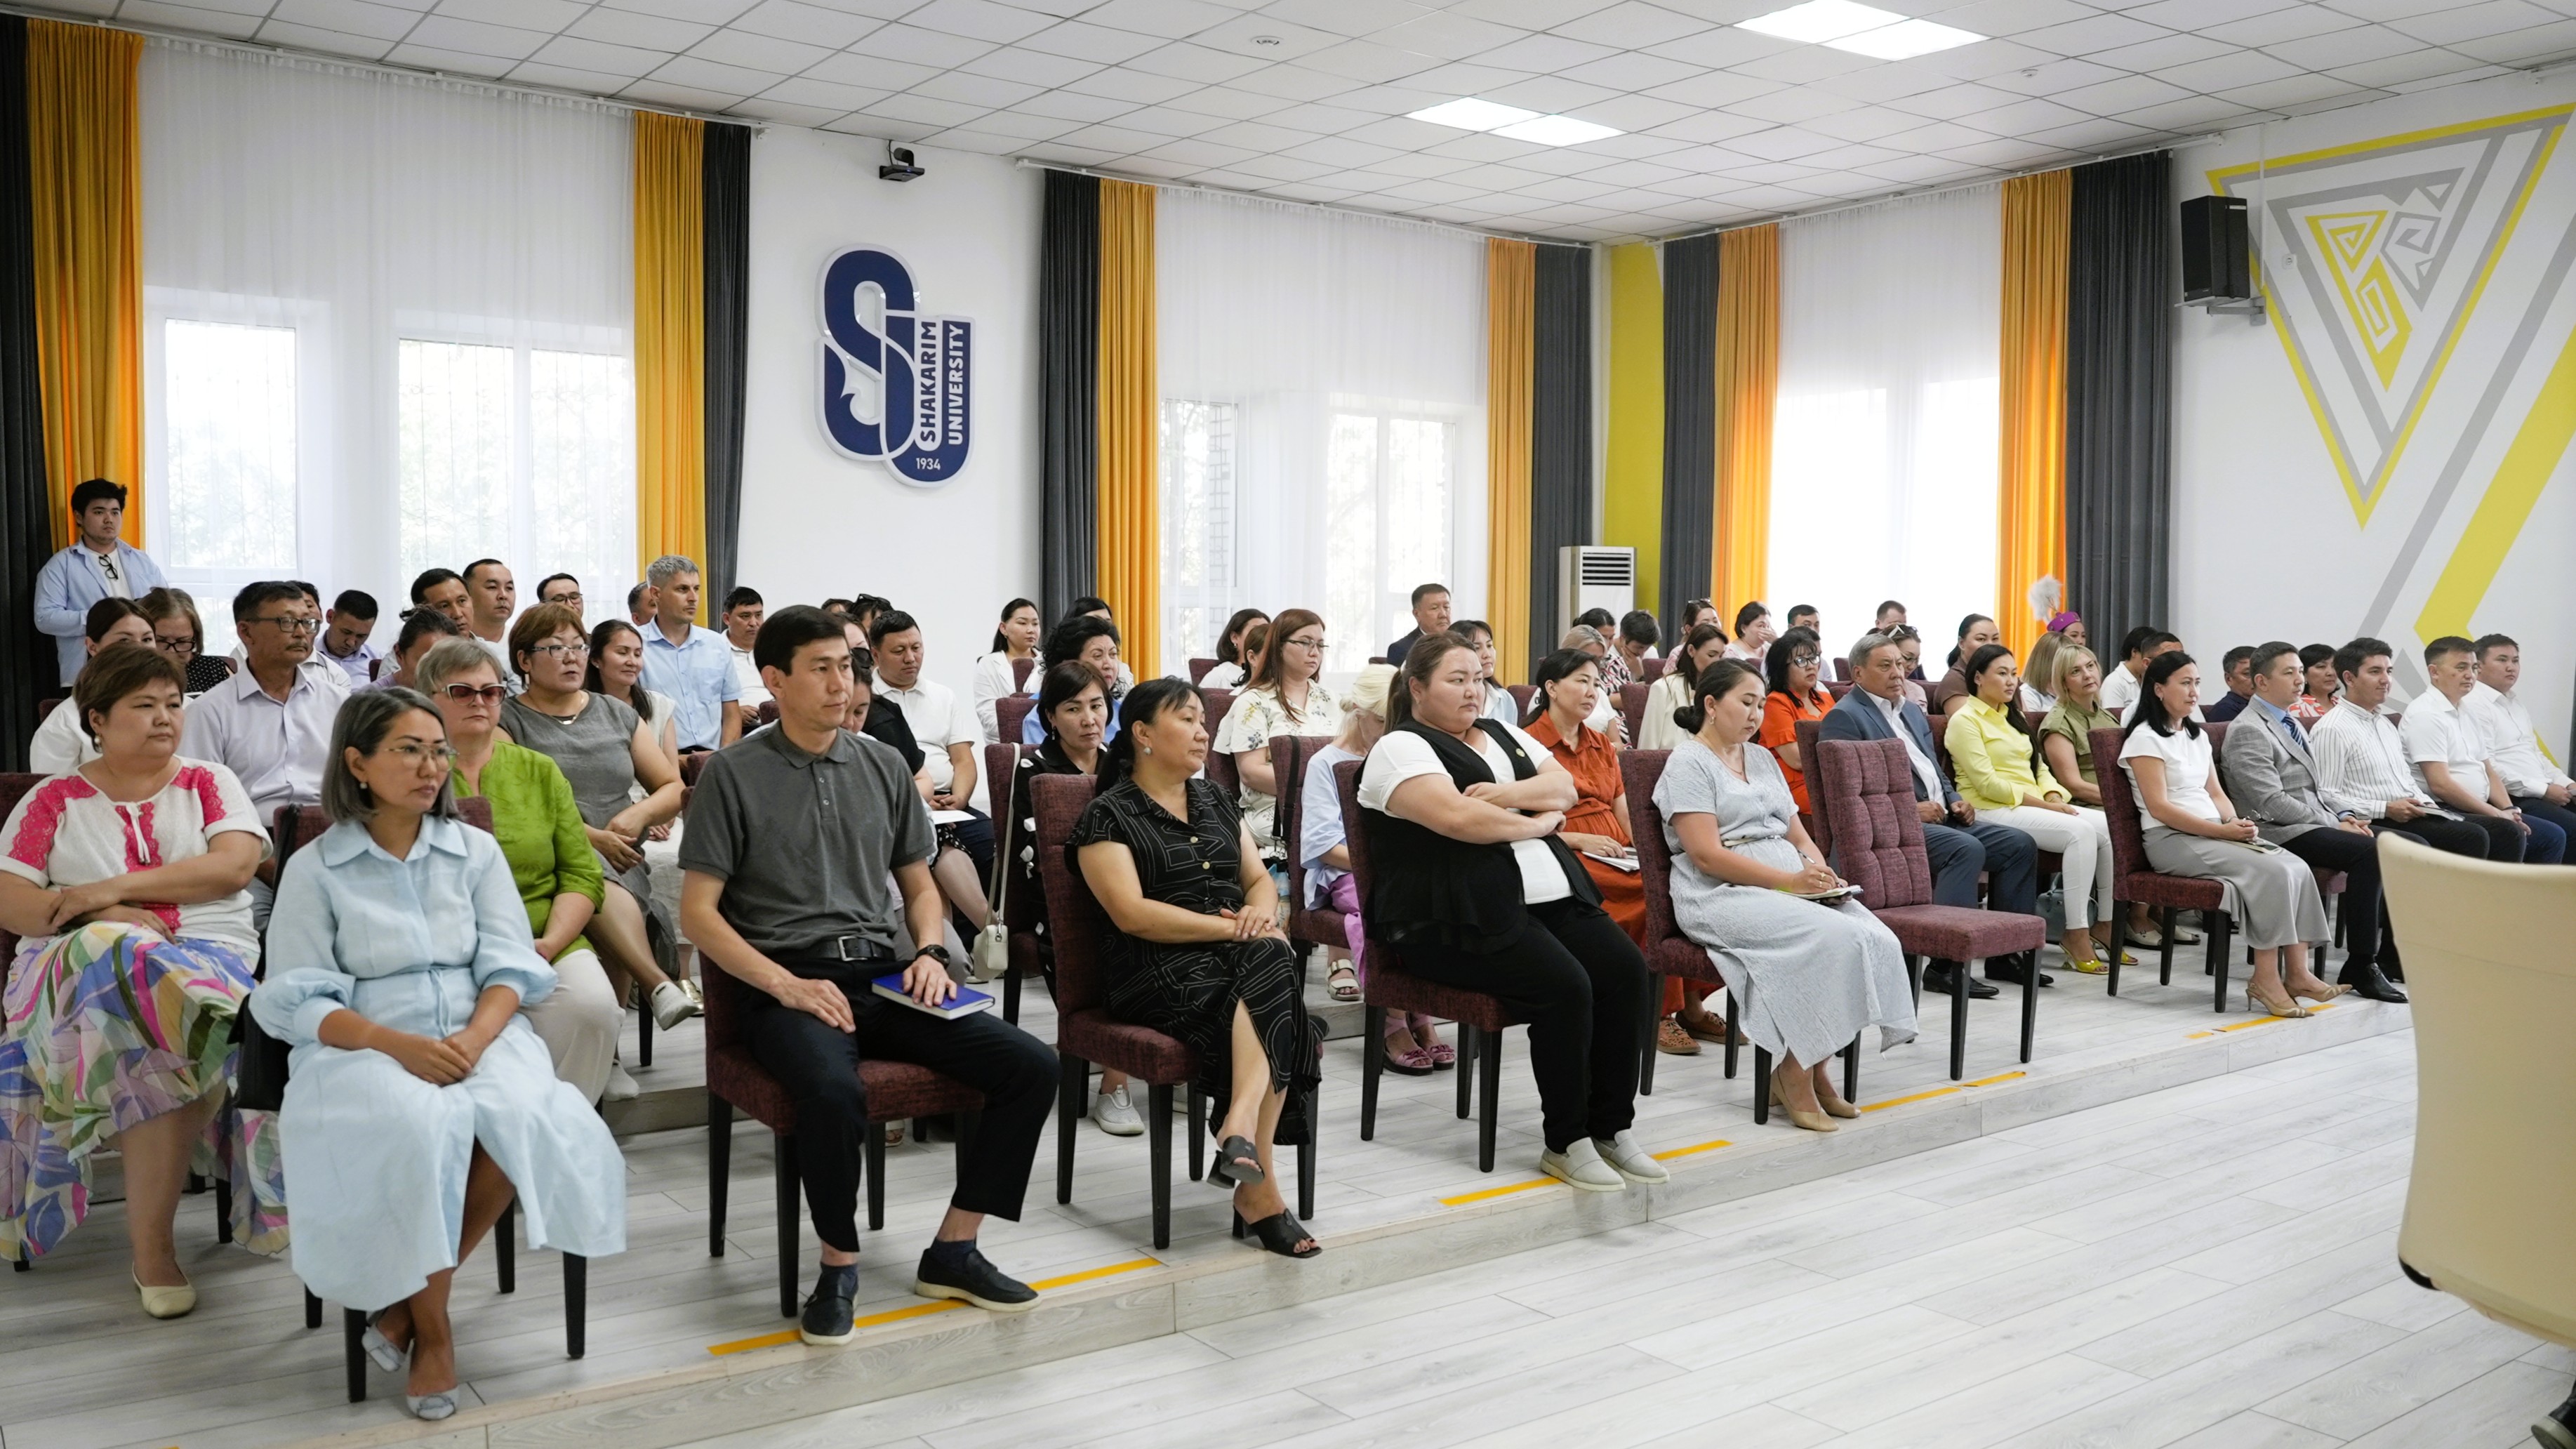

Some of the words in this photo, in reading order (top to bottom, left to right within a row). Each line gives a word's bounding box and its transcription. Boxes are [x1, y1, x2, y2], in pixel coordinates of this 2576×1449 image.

[920, 321, 937, 443] SHAKARIM
[948, 324, 964, 445] UNIVERSITY
[916, 458, 941, 470] 1934
